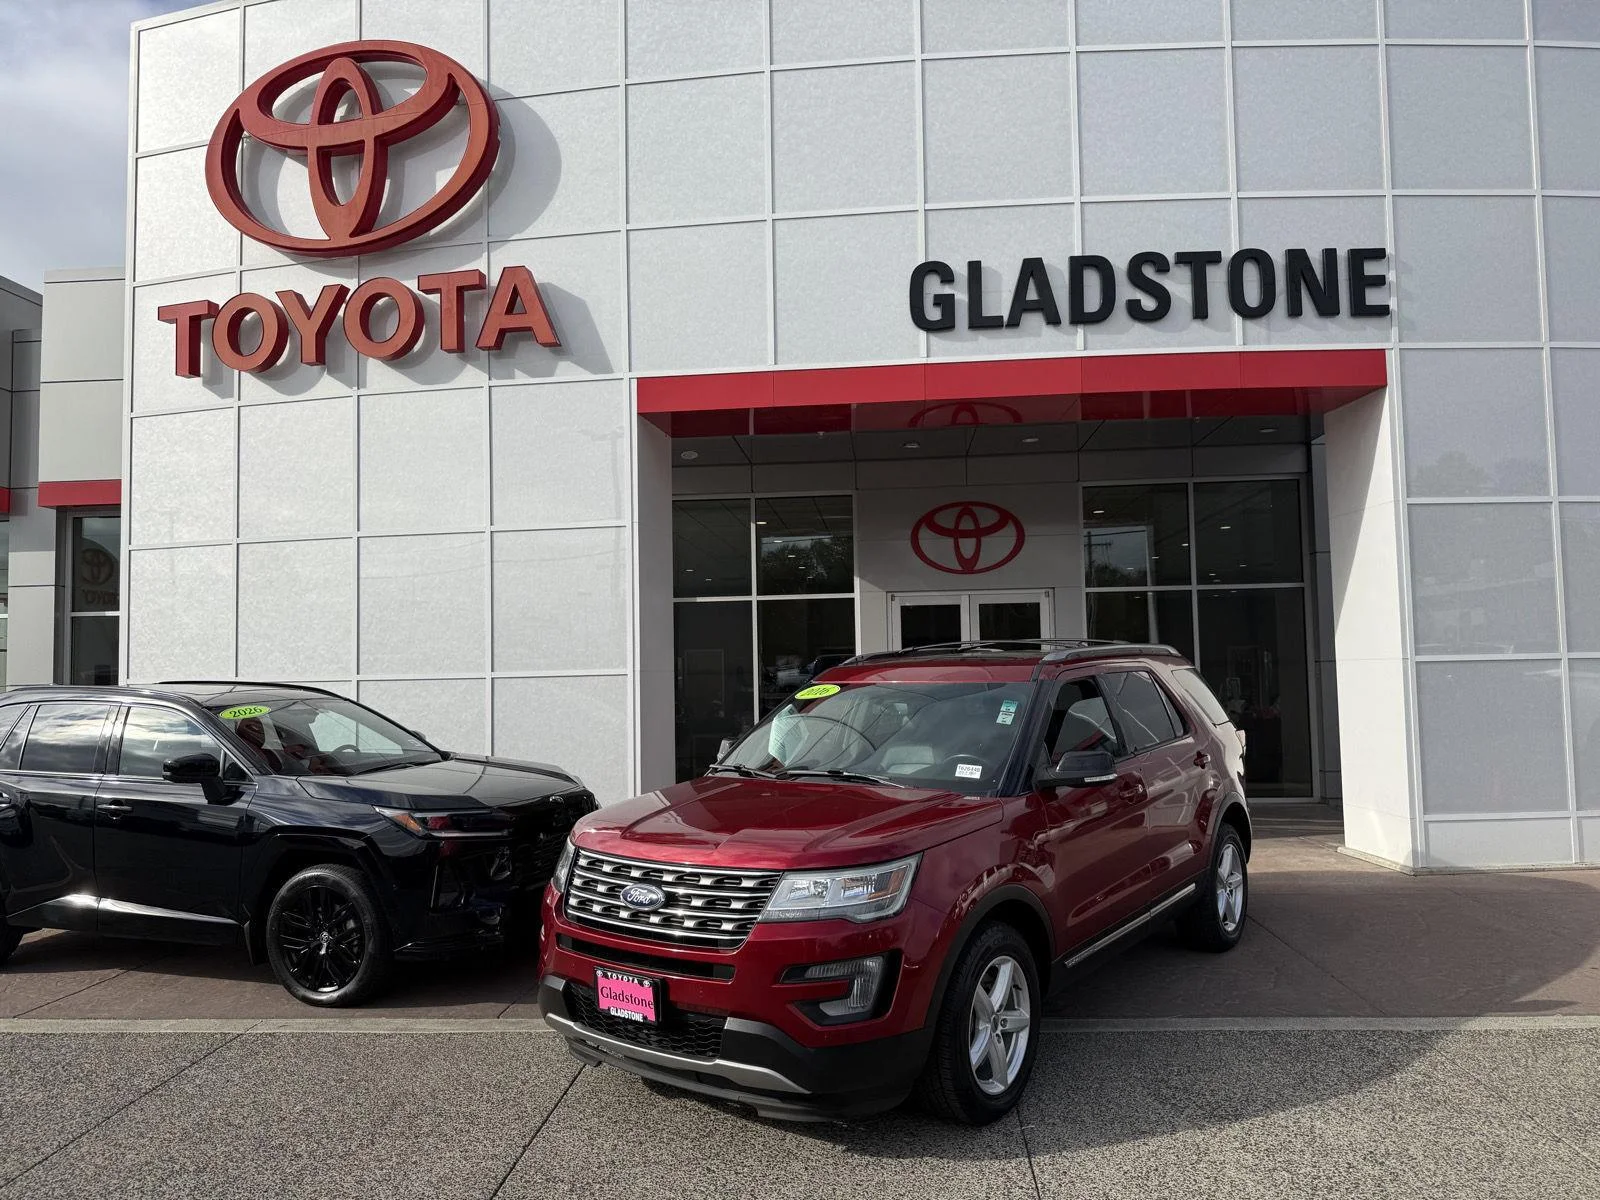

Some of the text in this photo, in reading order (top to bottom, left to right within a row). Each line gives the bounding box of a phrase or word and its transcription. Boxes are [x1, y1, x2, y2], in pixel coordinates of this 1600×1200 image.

[909, 247, 1391, 332] GLADSTONE
[157, 265, 562, 378] TOYOTA
[229, 706, 263, 718] 2026
[626, 887, 653, 904] Ford
[607, 972, 639, 985] TOYOTA
[600, 986, 654, 1010] Gladstone
[609, 1006, 644, 1022] GLADSTONE
